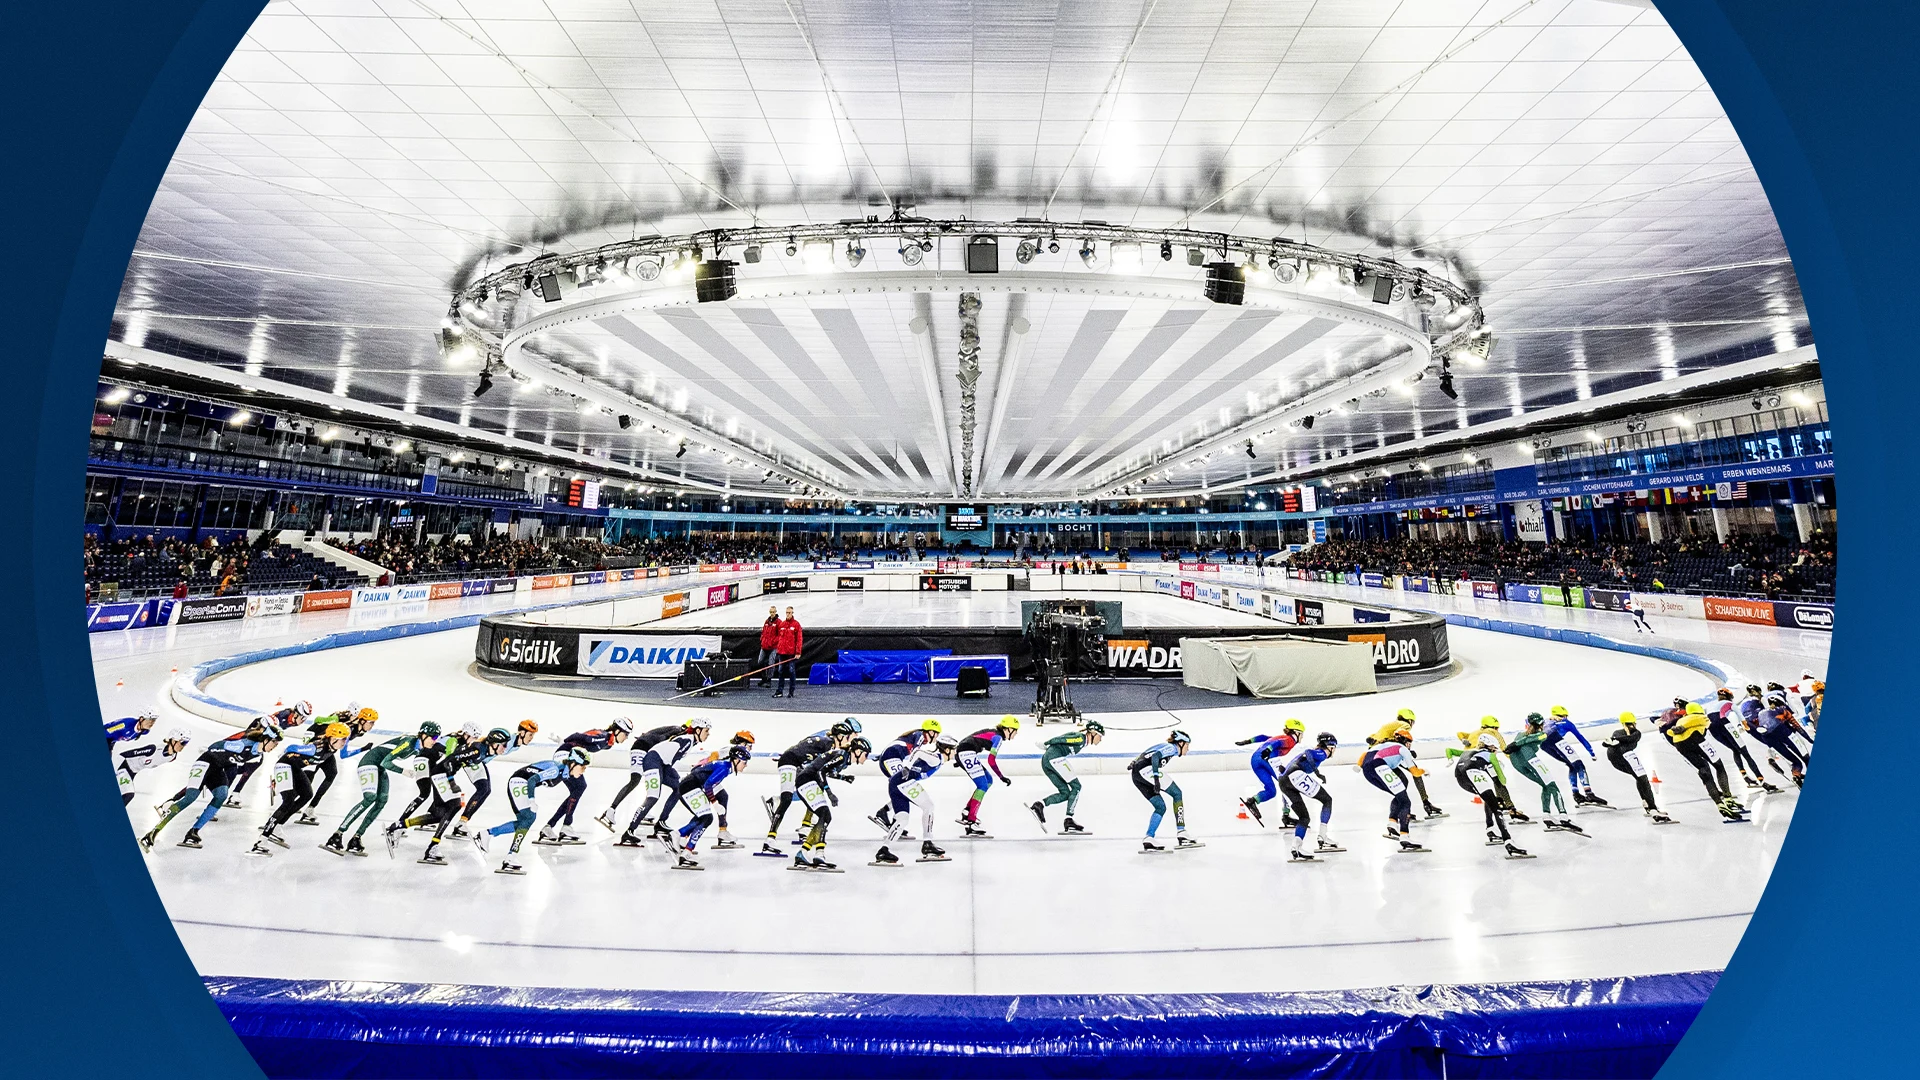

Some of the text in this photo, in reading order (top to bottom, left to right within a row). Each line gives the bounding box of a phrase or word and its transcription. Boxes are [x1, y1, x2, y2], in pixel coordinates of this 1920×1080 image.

[1722, 464, 1791, 478] ERBEN WENNEMARS
[1649, 473, 1704, 485] GERARD VAN VELDE
[1583, 480, 1634, 491] JOCHEM UYTDEHAAGE
[1537, 488, 1548, 496] CARL
[877, 508, 937, 520] SVEN
[994, 508, 1092, 520] KRAMER
[1525, 517, 1544, 532] thialf
[363, 591, 391, 602] DAIKIN
[403, 589, 427, 599] DAIKIN
[710, 587, 726, 603] essent
[1278, 603, 1293, 616] DAIKIN
[1715, 604, 1771, 620] SCHAATSEN.NL/LIVE
[510, 638, 563, 665] Sidijk
[609, 647, 706, 664] DAIKIN
[1373, 638, 1420, 665] ADRO
[1565, 745, 1574, 755] 8
[890, 764, 903, 774] 50
[964, 757, 981, 769] 84
[276, 771, 288, 783] 61
[360, 772, 374, 785] 51
[780, 772, 793, 784] 31
[1298, 775, 1313, 792] 37
[805, 787, 824, 801] 64
